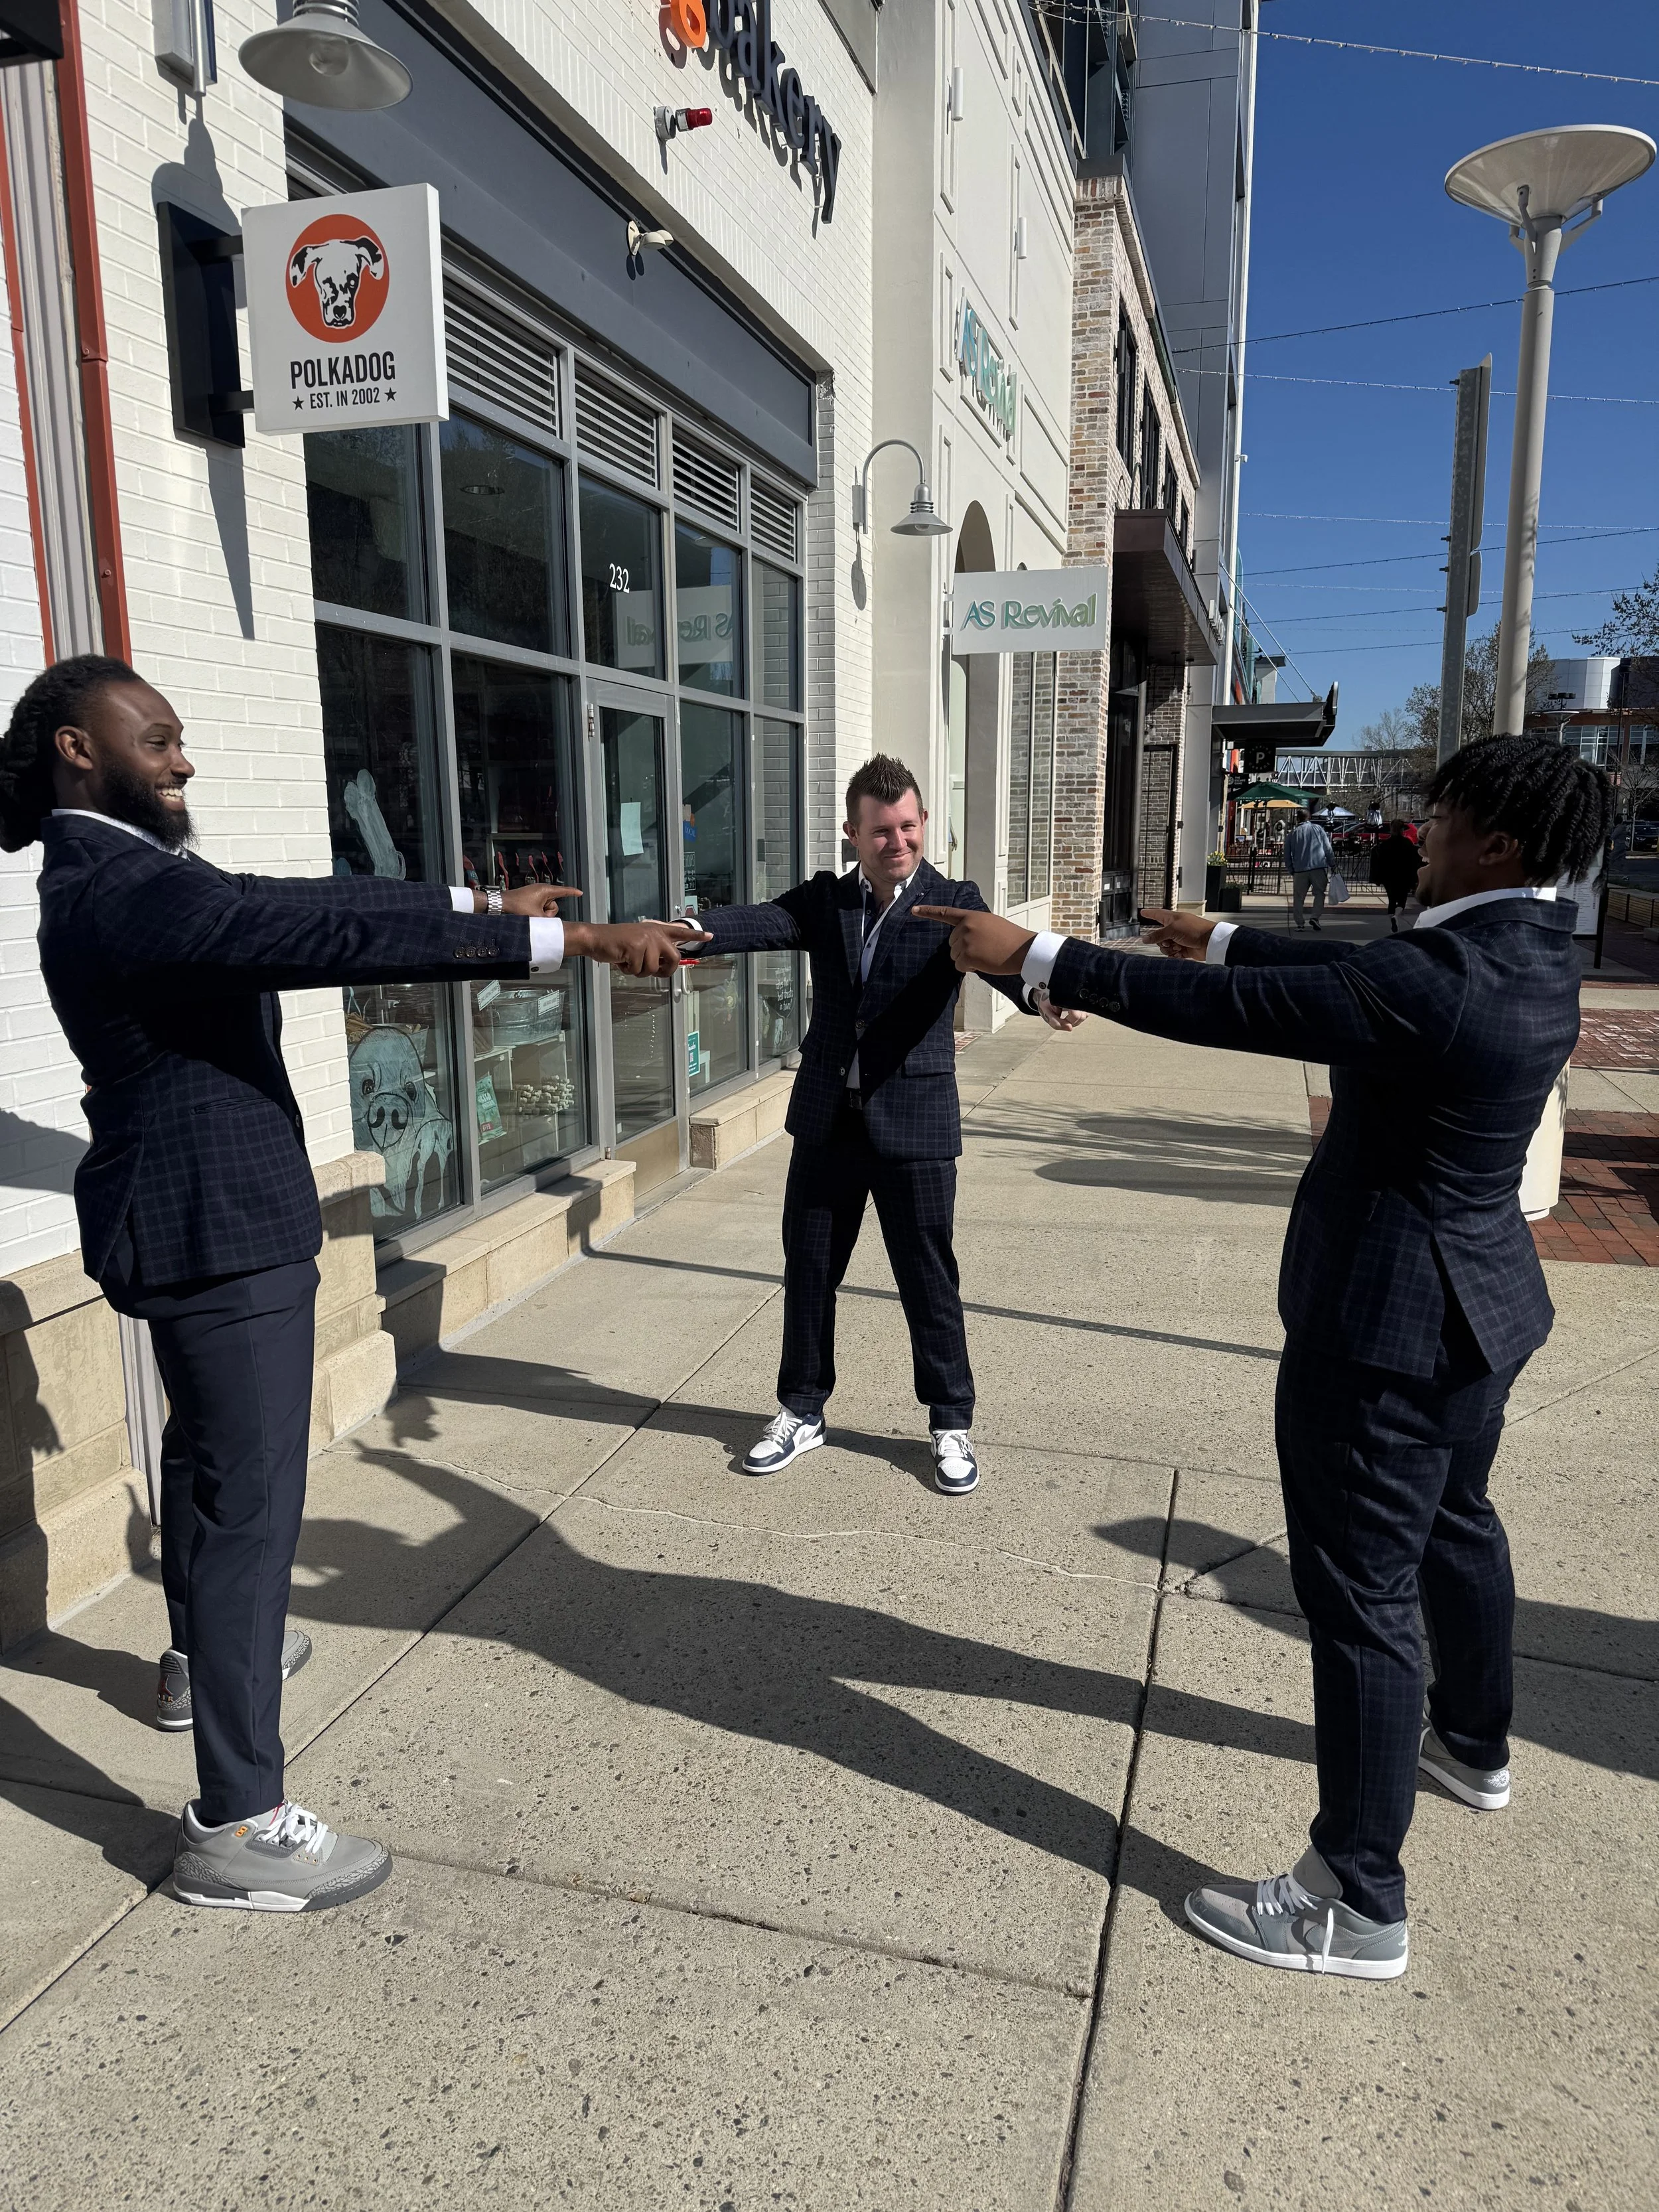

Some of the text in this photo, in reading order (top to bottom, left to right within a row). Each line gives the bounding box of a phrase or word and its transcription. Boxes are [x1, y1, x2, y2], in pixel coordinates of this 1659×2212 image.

[290, 350, 396, 390] POLKADOG
[309, 387, 380, 409] EST. IN 2002
[609, 563, 630, 593] 232
[960, 593, 1097, 630] AS Revival
[1256, 752, 1265, 764] P
